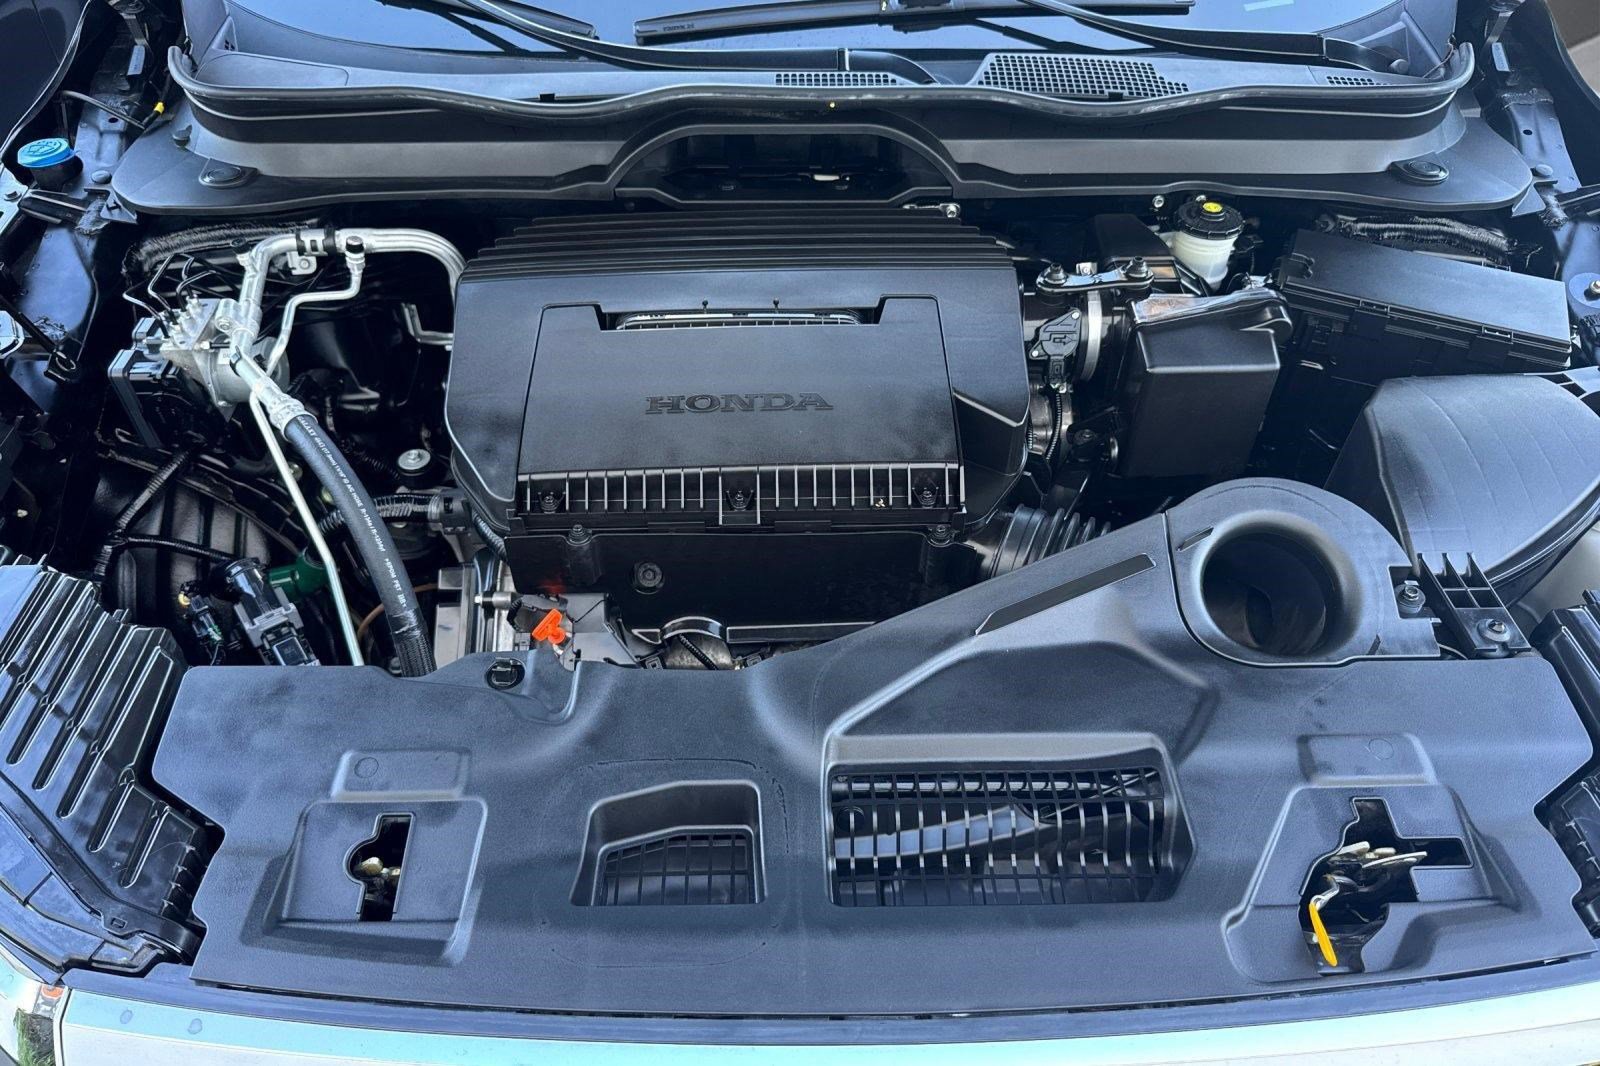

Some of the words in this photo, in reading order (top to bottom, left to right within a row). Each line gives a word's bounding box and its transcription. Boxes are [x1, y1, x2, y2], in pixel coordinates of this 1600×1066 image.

[645, 393, 833, 414] HONDA
[297, 415, 317, 437] GALAXY
[352, 492, 364, 507] HOSE
